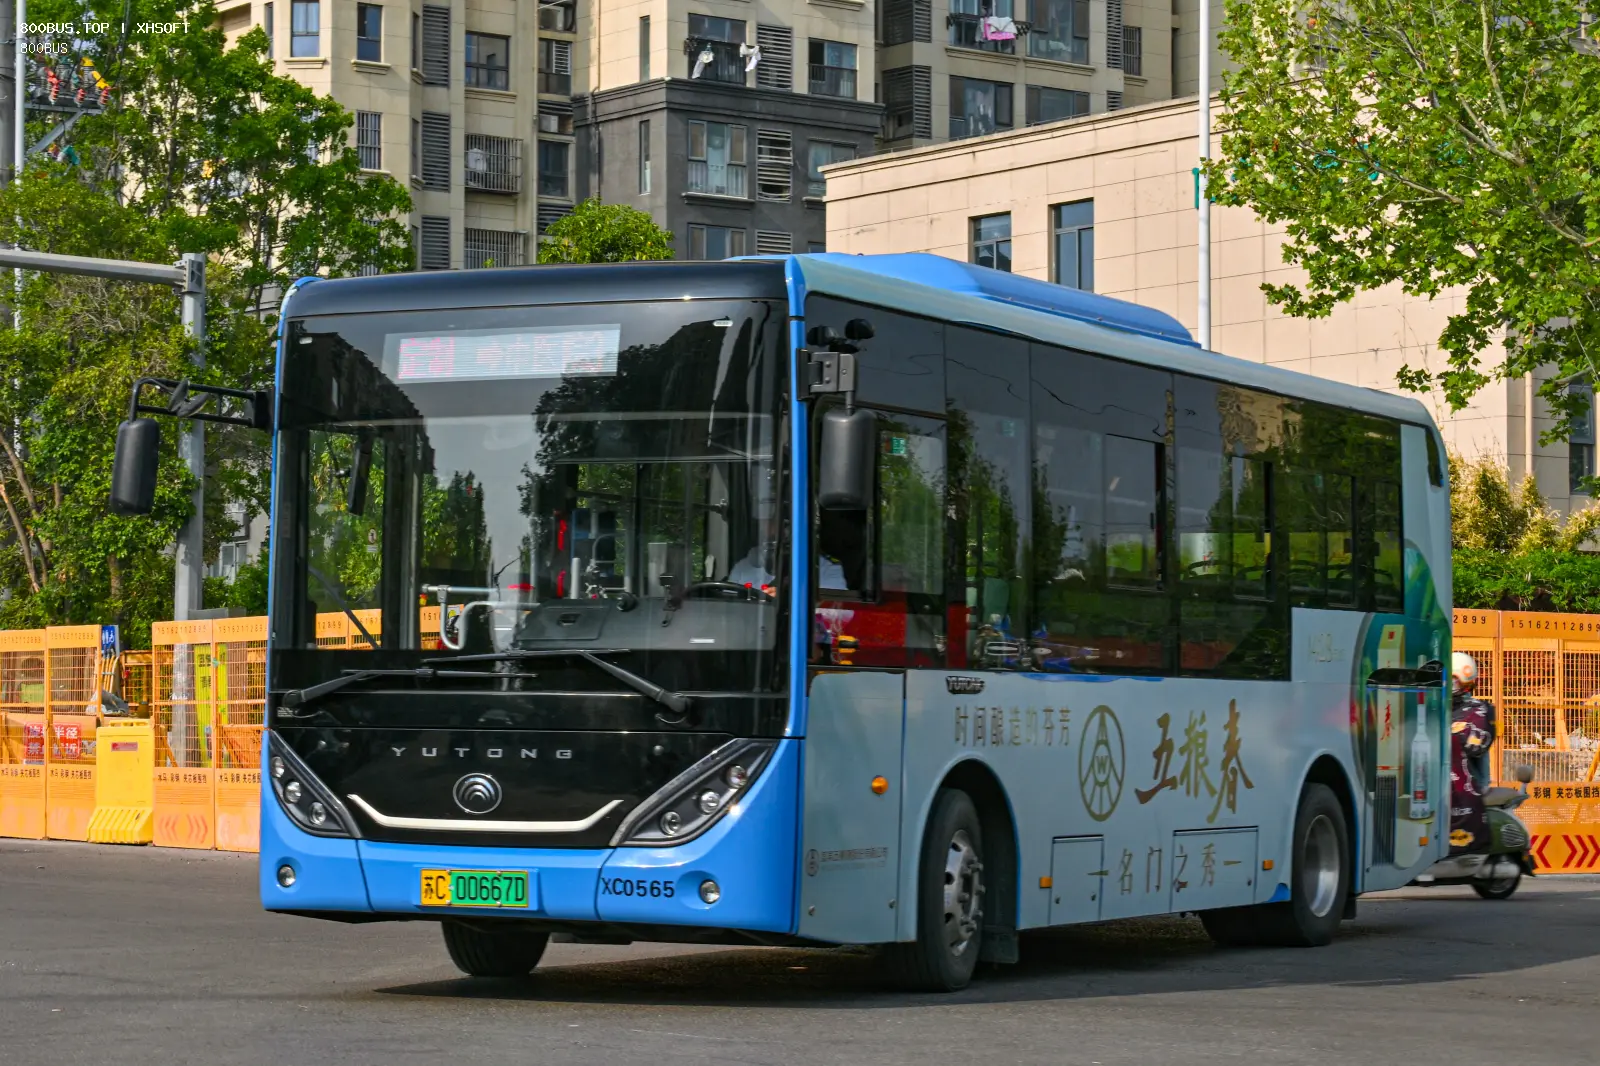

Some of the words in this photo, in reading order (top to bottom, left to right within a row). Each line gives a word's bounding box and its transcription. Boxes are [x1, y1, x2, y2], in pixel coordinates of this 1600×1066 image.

[1511, 619, 1600, 632] 15162112899
[391, 746, 573, 760] YUTONG
[1533, 786, 1551, 799] 彩钢
[601, 876, 675, 899] XC0565
